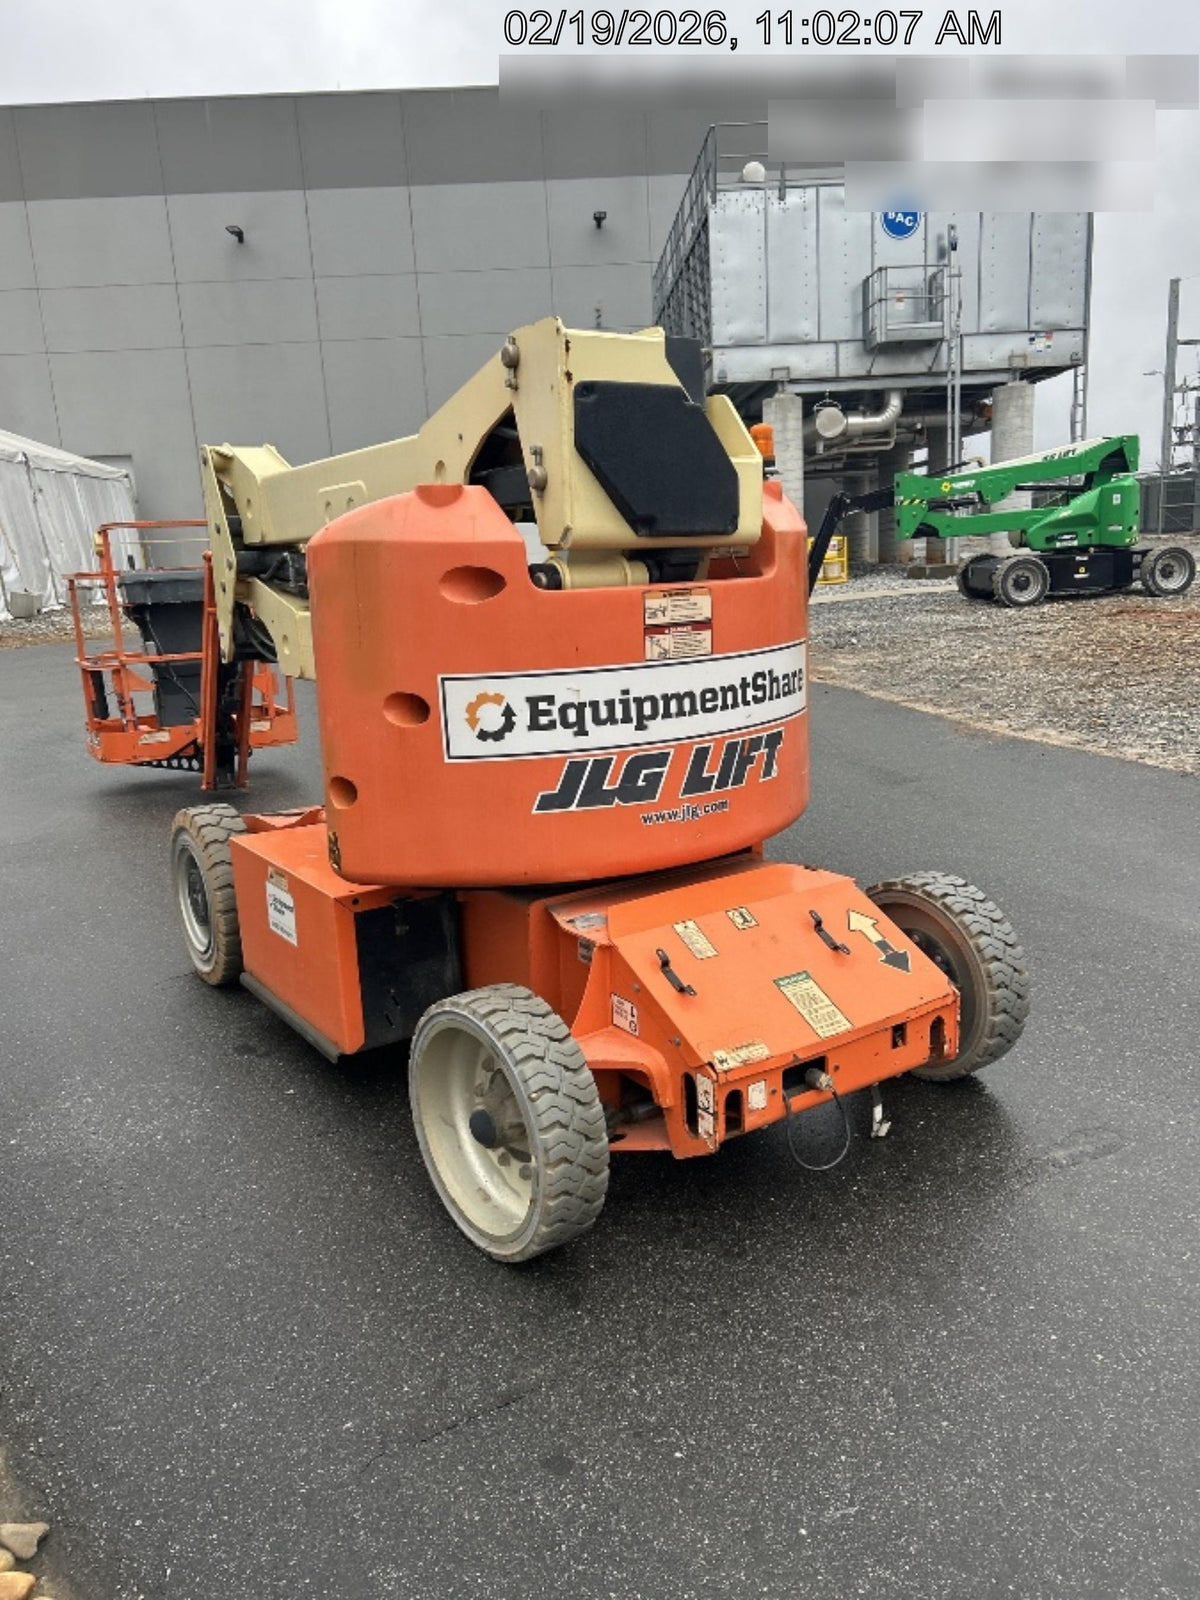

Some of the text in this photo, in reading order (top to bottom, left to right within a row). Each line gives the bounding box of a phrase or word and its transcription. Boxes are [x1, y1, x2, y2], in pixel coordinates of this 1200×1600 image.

[525, 668, 803, 738] EquipmentShare
[531, 727, 785, 813] JLG LIFT
[641, 799, 730, 825] www.jlg.com
